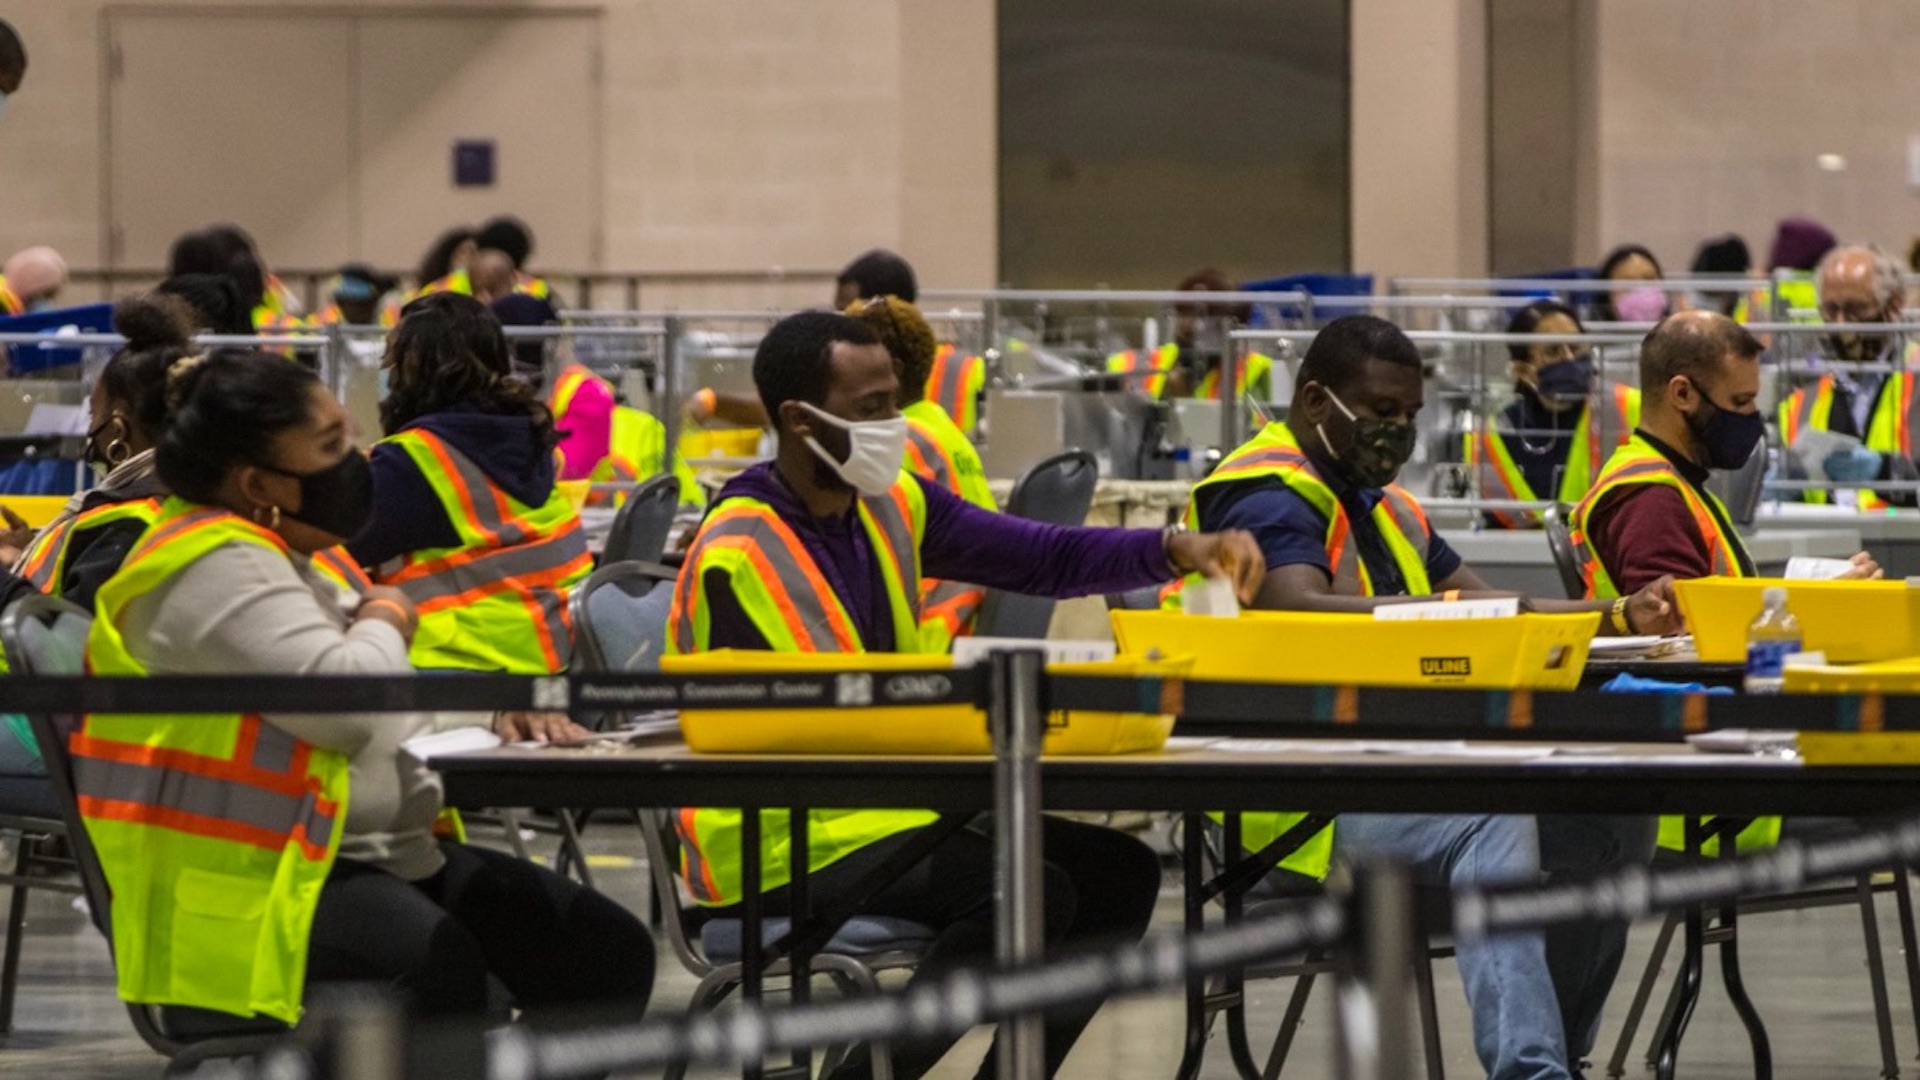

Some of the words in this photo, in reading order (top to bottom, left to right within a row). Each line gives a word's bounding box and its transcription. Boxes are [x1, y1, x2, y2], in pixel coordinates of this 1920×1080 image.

[1422, 659, 1470, 674] ULINE
[683, 681, 767, 699] Convention
[773, 680, 823, 698] Center
